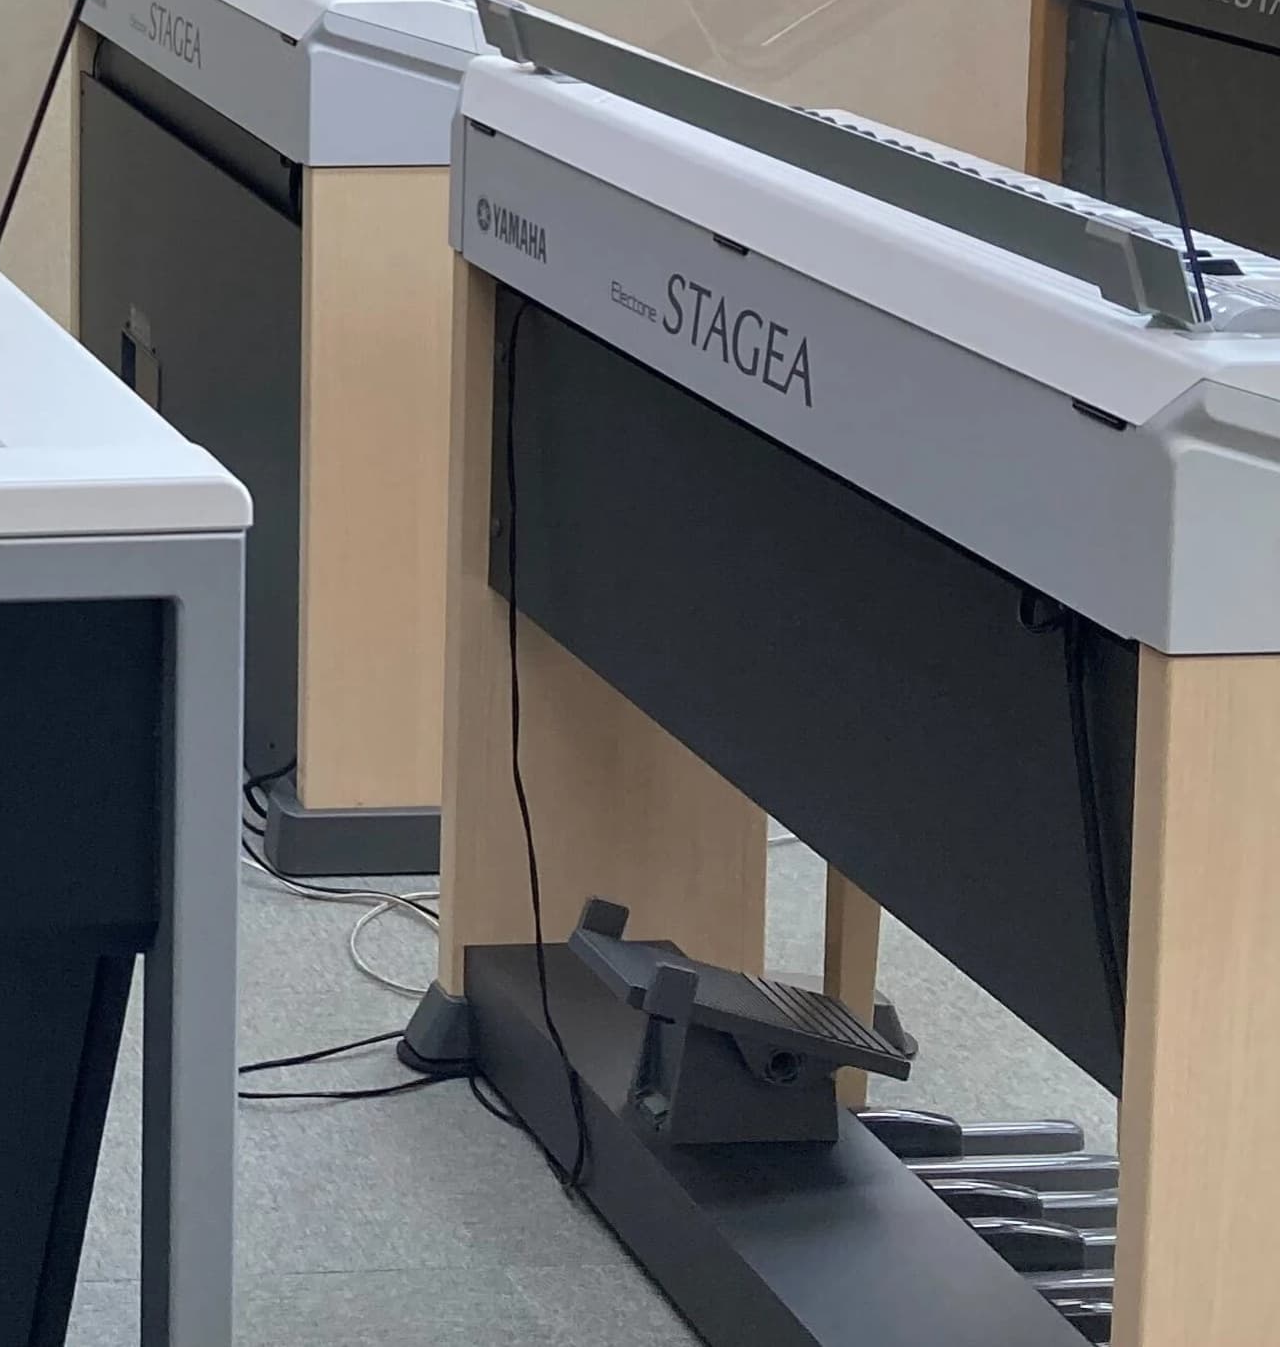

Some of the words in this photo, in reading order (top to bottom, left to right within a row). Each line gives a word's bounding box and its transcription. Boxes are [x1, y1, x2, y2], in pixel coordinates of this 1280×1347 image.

[148, 2, 202, 69] STAGEA
[492, 203, 547, 264] YAMAHA
[611, 280, 657, 323] Electone
[662, 273, 813, 408] STAGEA
